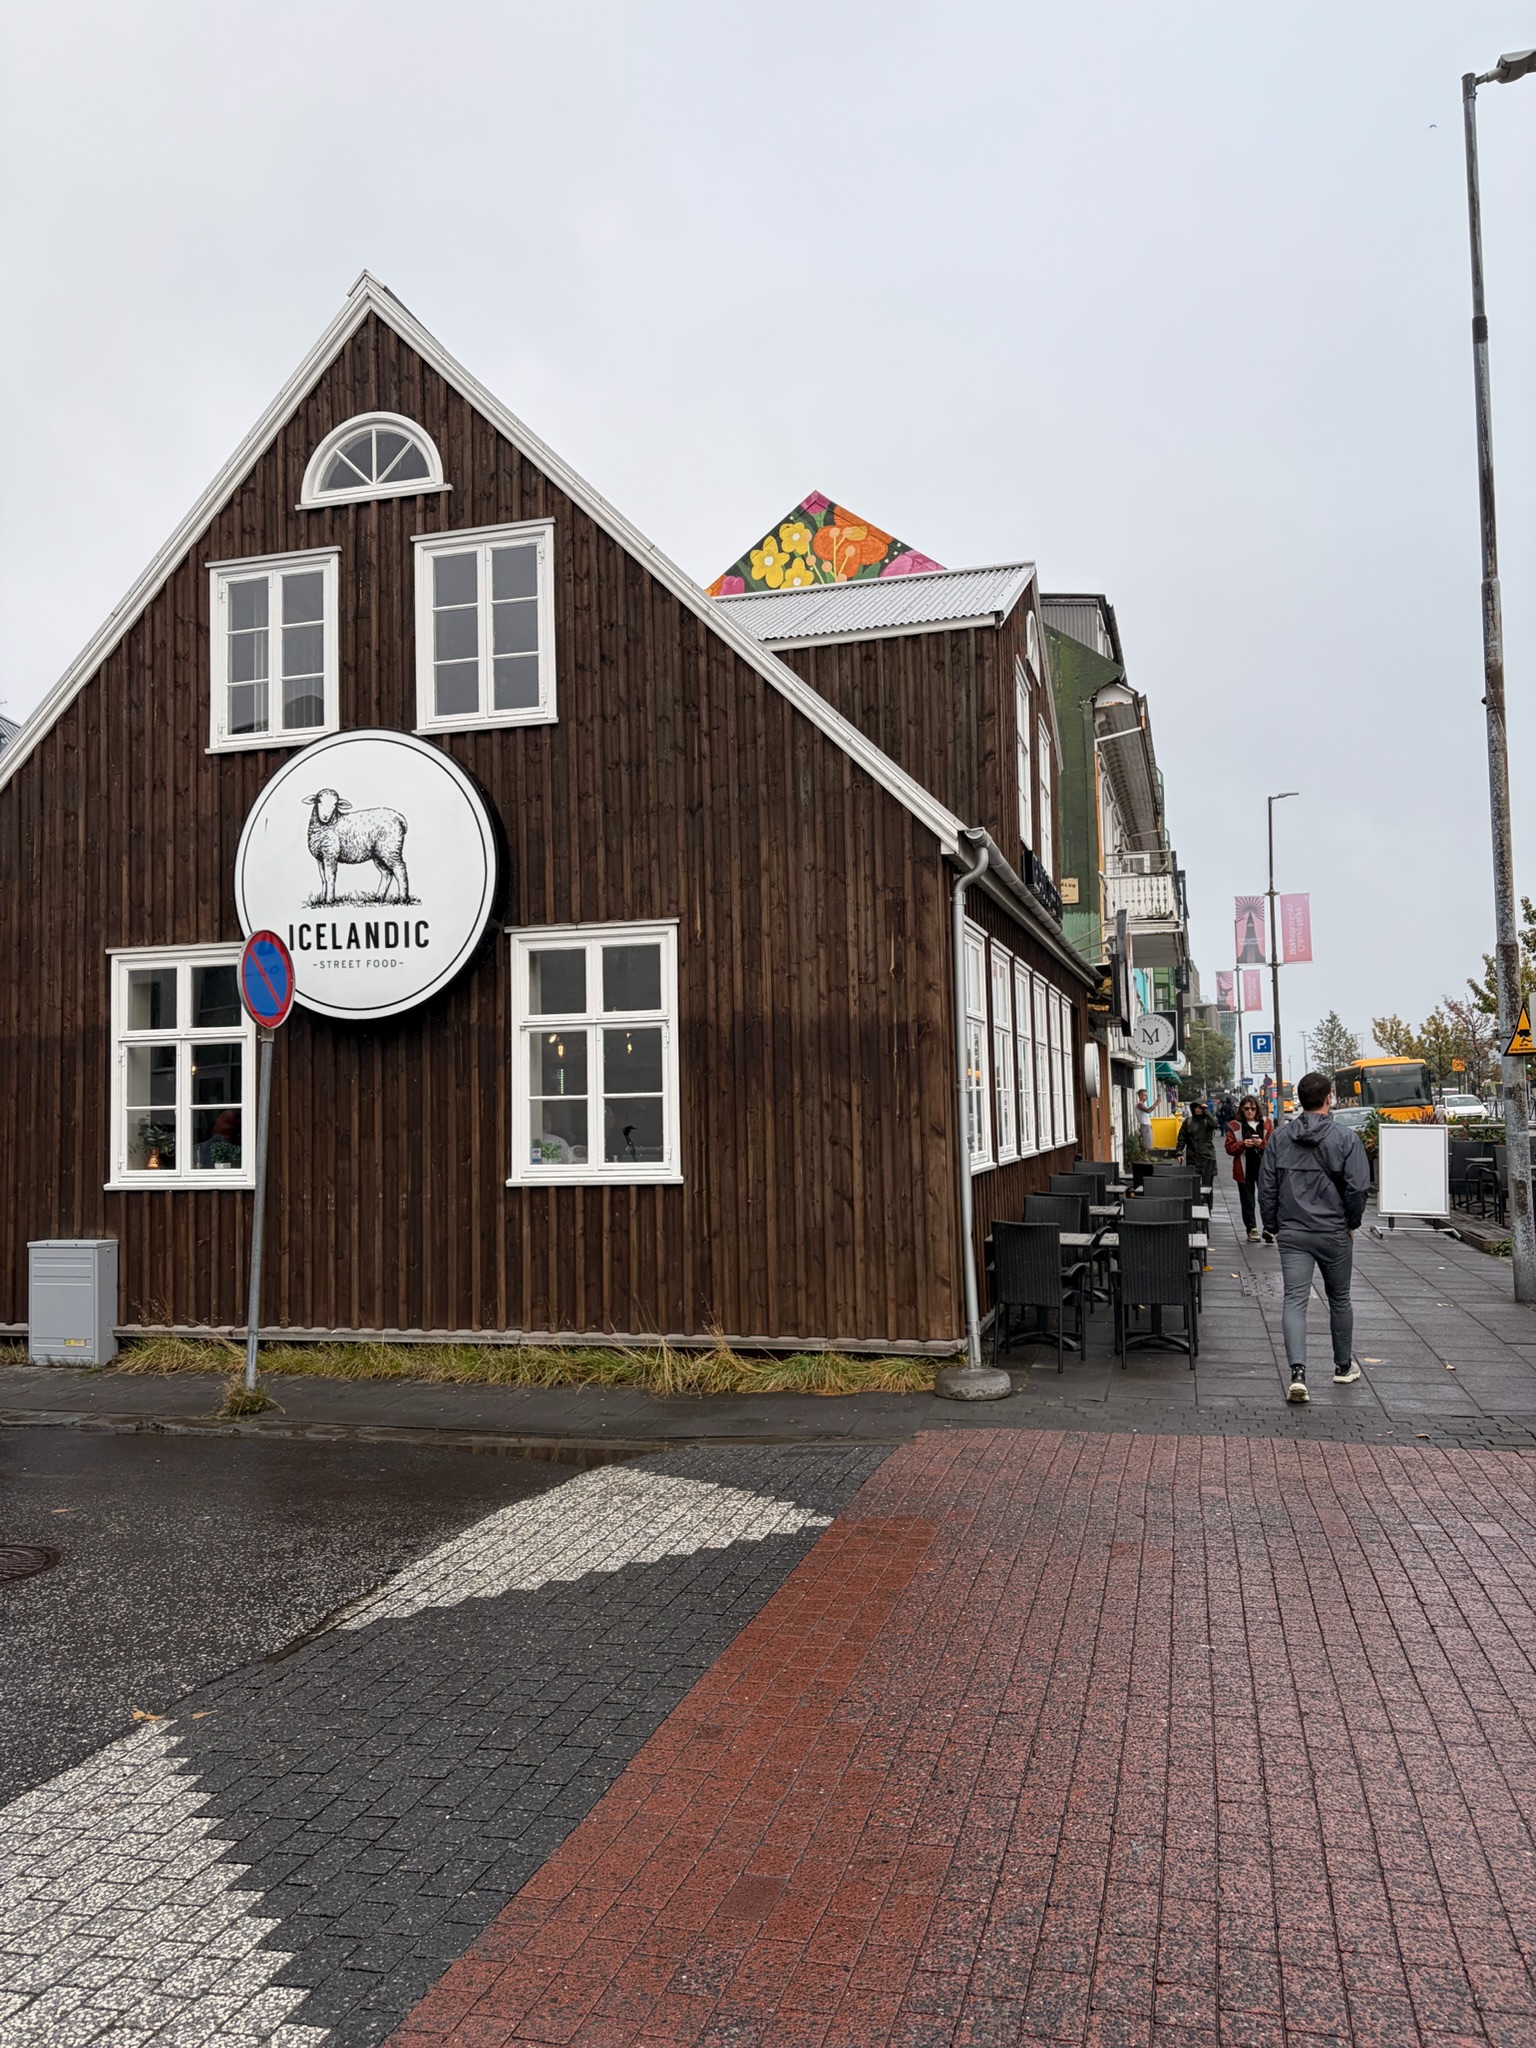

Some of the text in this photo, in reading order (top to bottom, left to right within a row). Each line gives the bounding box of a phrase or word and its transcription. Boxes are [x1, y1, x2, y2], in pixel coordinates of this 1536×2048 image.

[288, 920, 430, 951] ICELANDIC
[1141, 1028, 1160, 1046] M
[1135, 1044, 1168, 1056] RESTAURANT
